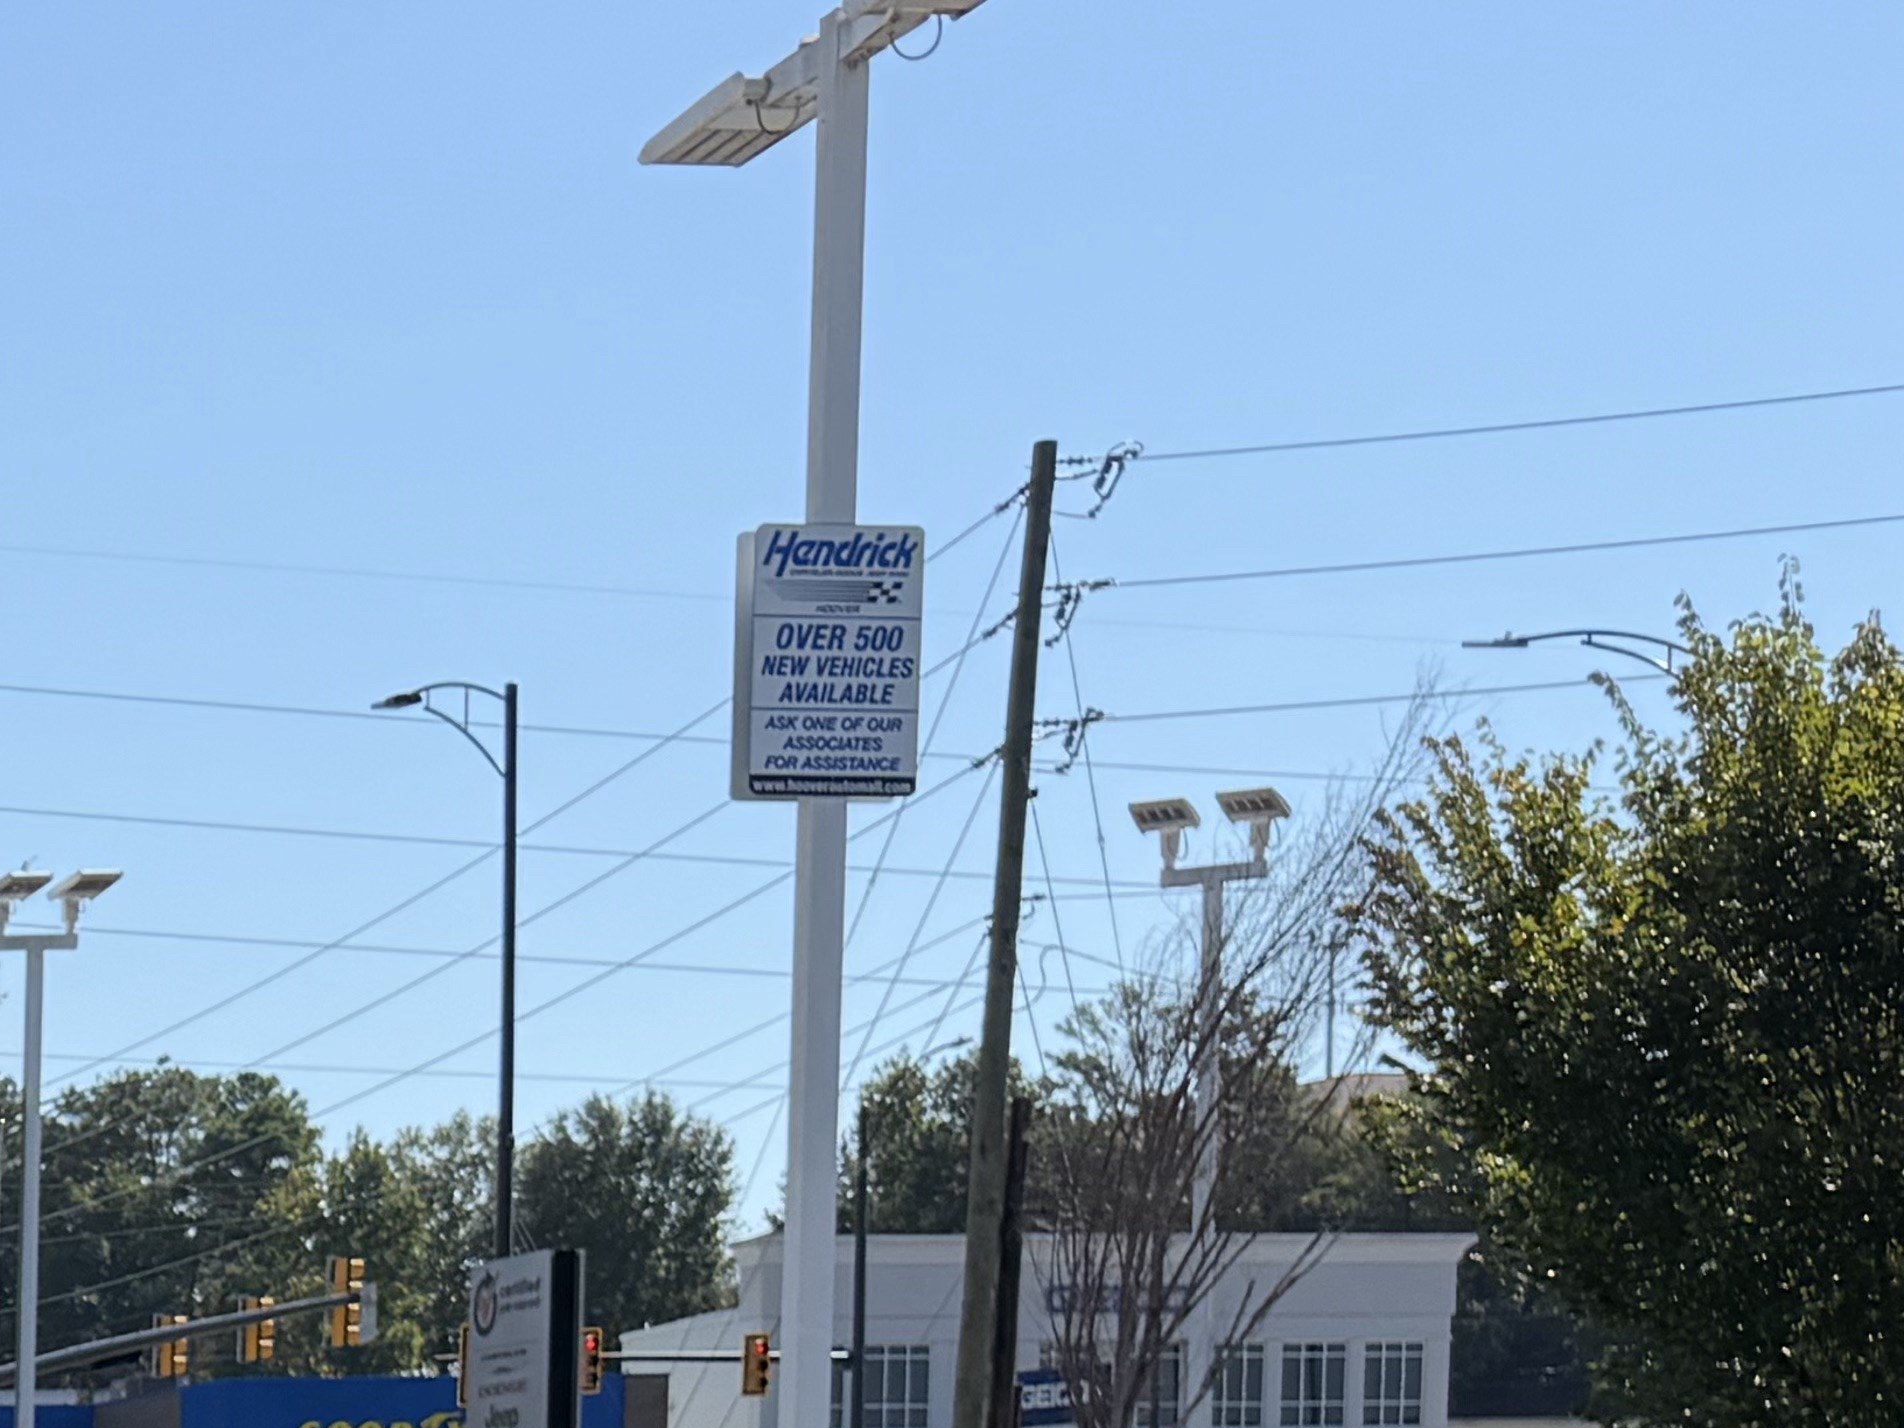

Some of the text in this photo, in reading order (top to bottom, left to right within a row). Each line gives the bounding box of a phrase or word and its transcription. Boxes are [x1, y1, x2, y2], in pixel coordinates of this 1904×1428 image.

[764, 530, 918, 577] Hendrick
[776, 623, 904, 653] OVER 500
[762, 656, 914, 679] NEW VEHICLES
[779, 683, 894, 705] AVAILABLE
[765, 716, 903, 732] ASK ONE OF OUR
[783, 736, 883, 752] ASSOCIATES
[765, 755, 901, 772] FOR ASSISTANCE
